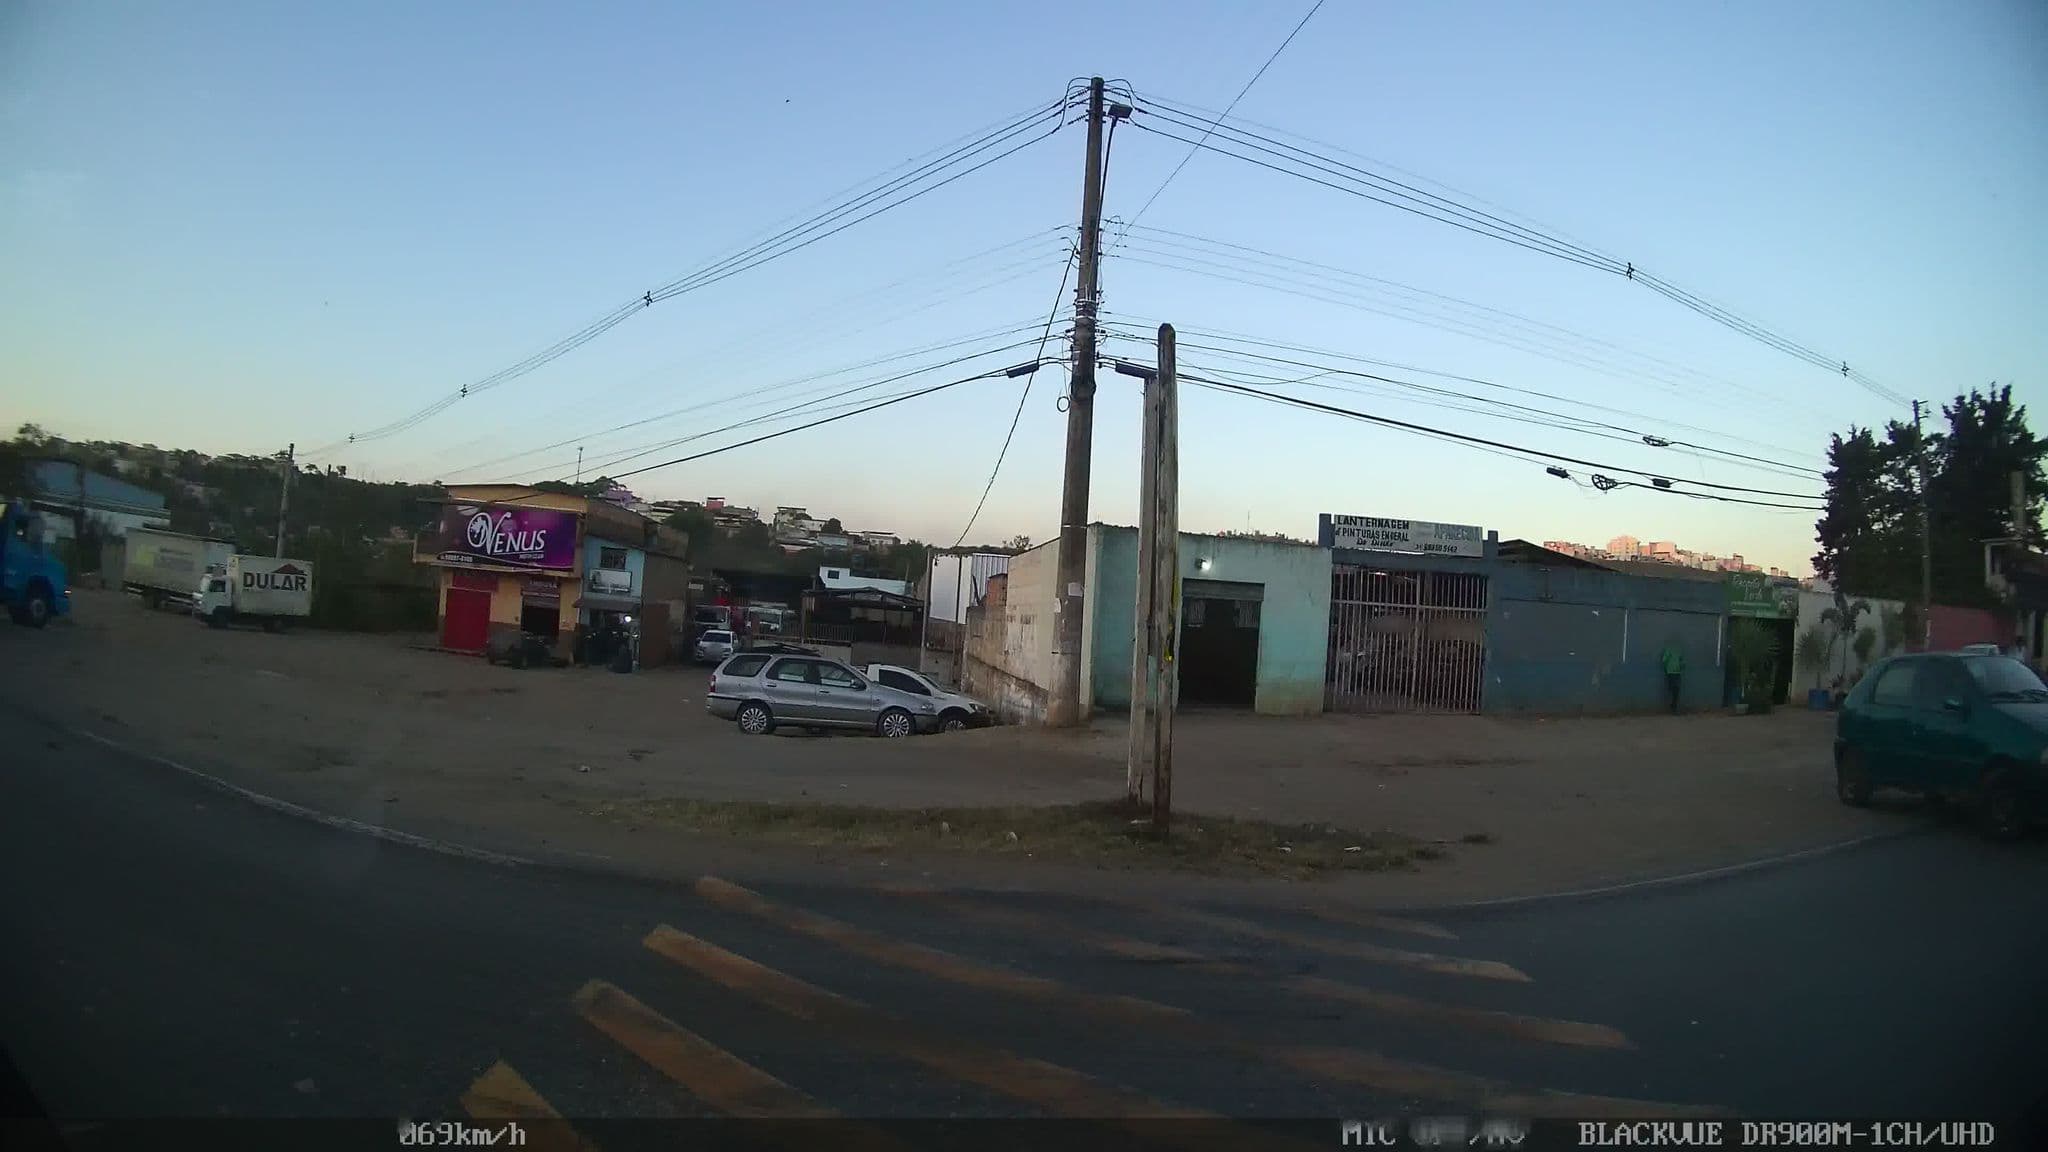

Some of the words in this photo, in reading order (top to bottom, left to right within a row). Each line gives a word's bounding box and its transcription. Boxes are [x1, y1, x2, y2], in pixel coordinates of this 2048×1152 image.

[1337, 515, 1409, 530] LANTERNAGEM
[468, 511, 546, 554] VENUS
[1342, 528, 1380, 539] PINTURAS
[243, 572, 307, 591] DULAR
